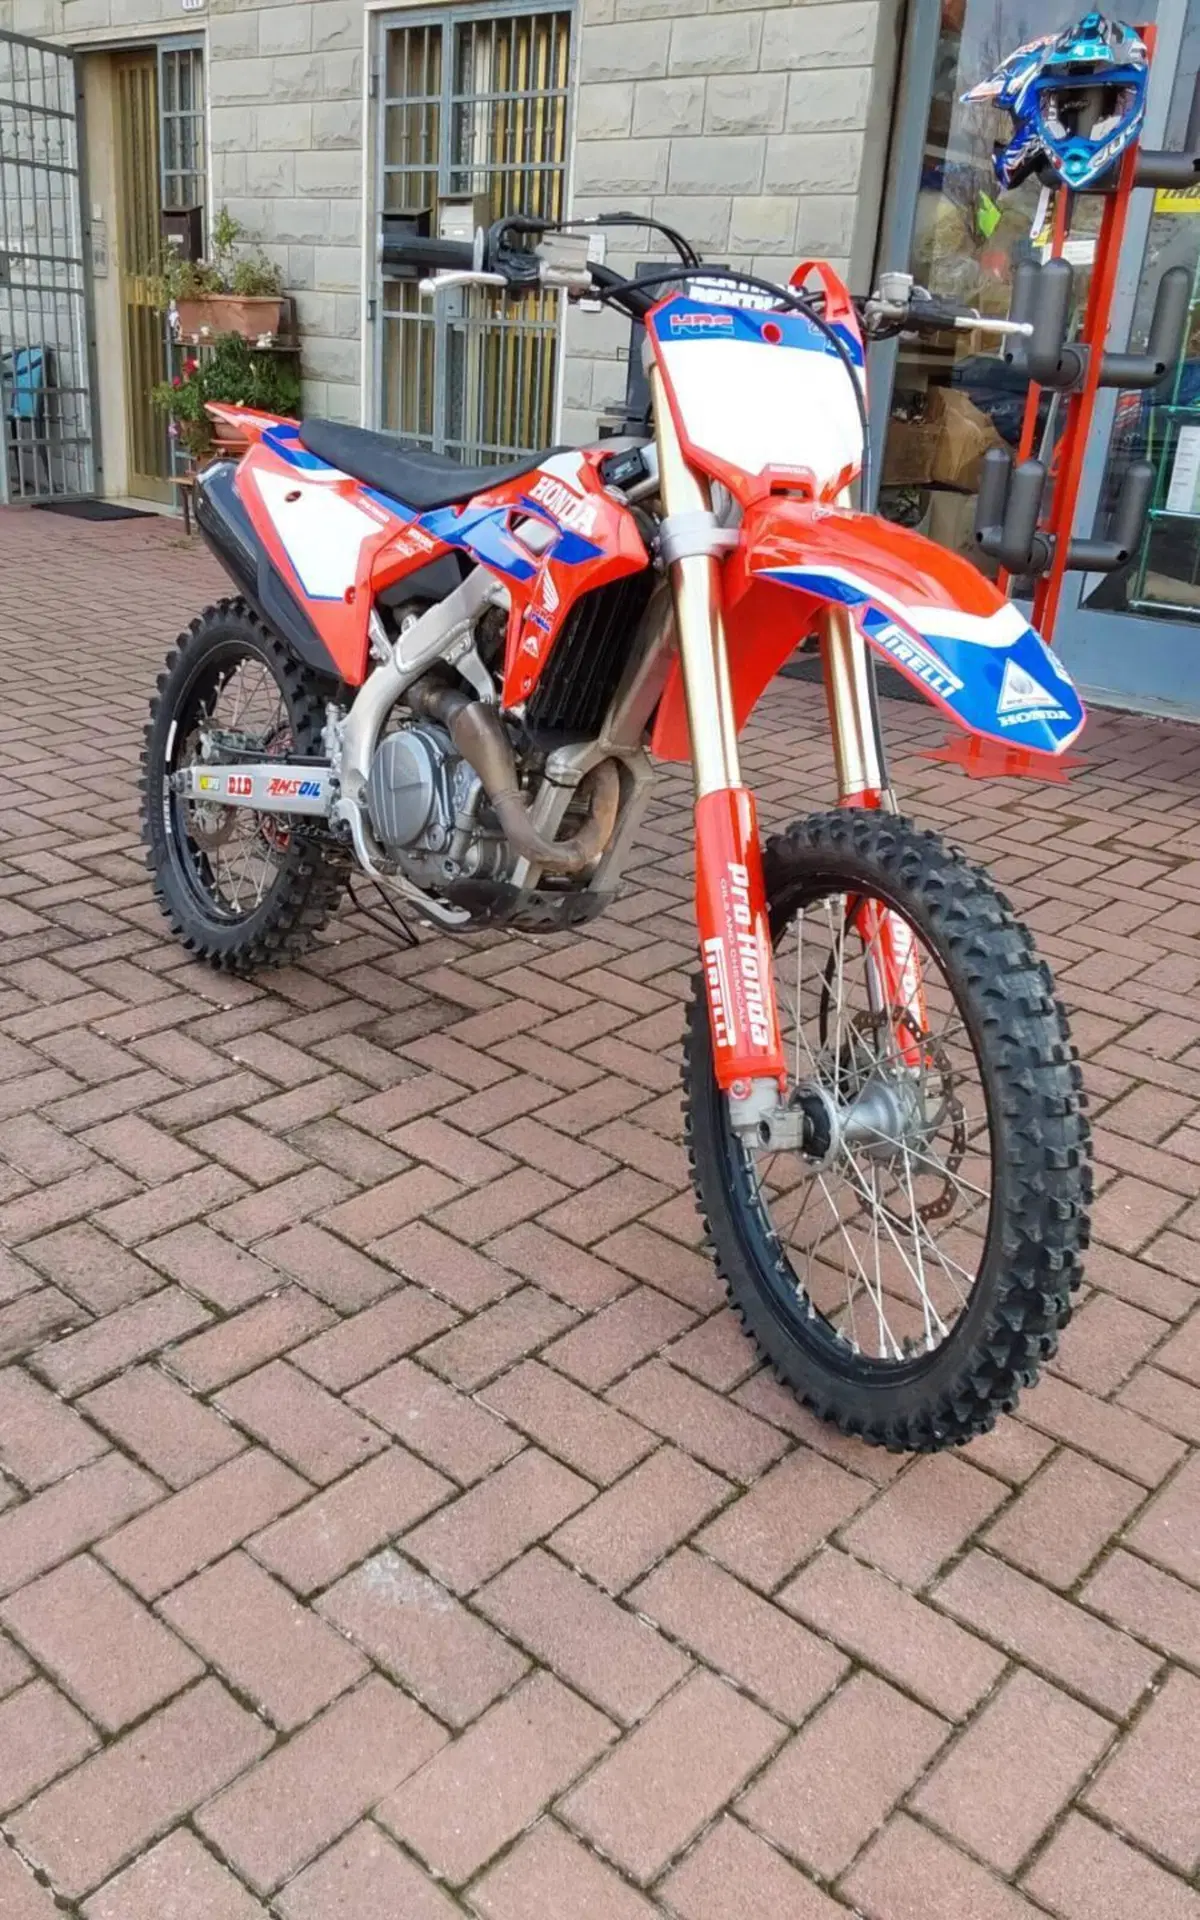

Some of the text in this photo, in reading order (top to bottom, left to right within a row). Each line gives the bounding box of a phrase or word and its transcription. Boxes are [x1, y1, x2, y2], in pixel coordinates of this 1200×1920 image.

[528, 476, 598, 537] HONDA
[875, 624, 965, 698] PIRELLI
[997, 710, 1073, 728] HONDA
[267, 778, 321, 797] AMSOIL
[704, 936, 737, 1047] PIRELLI
